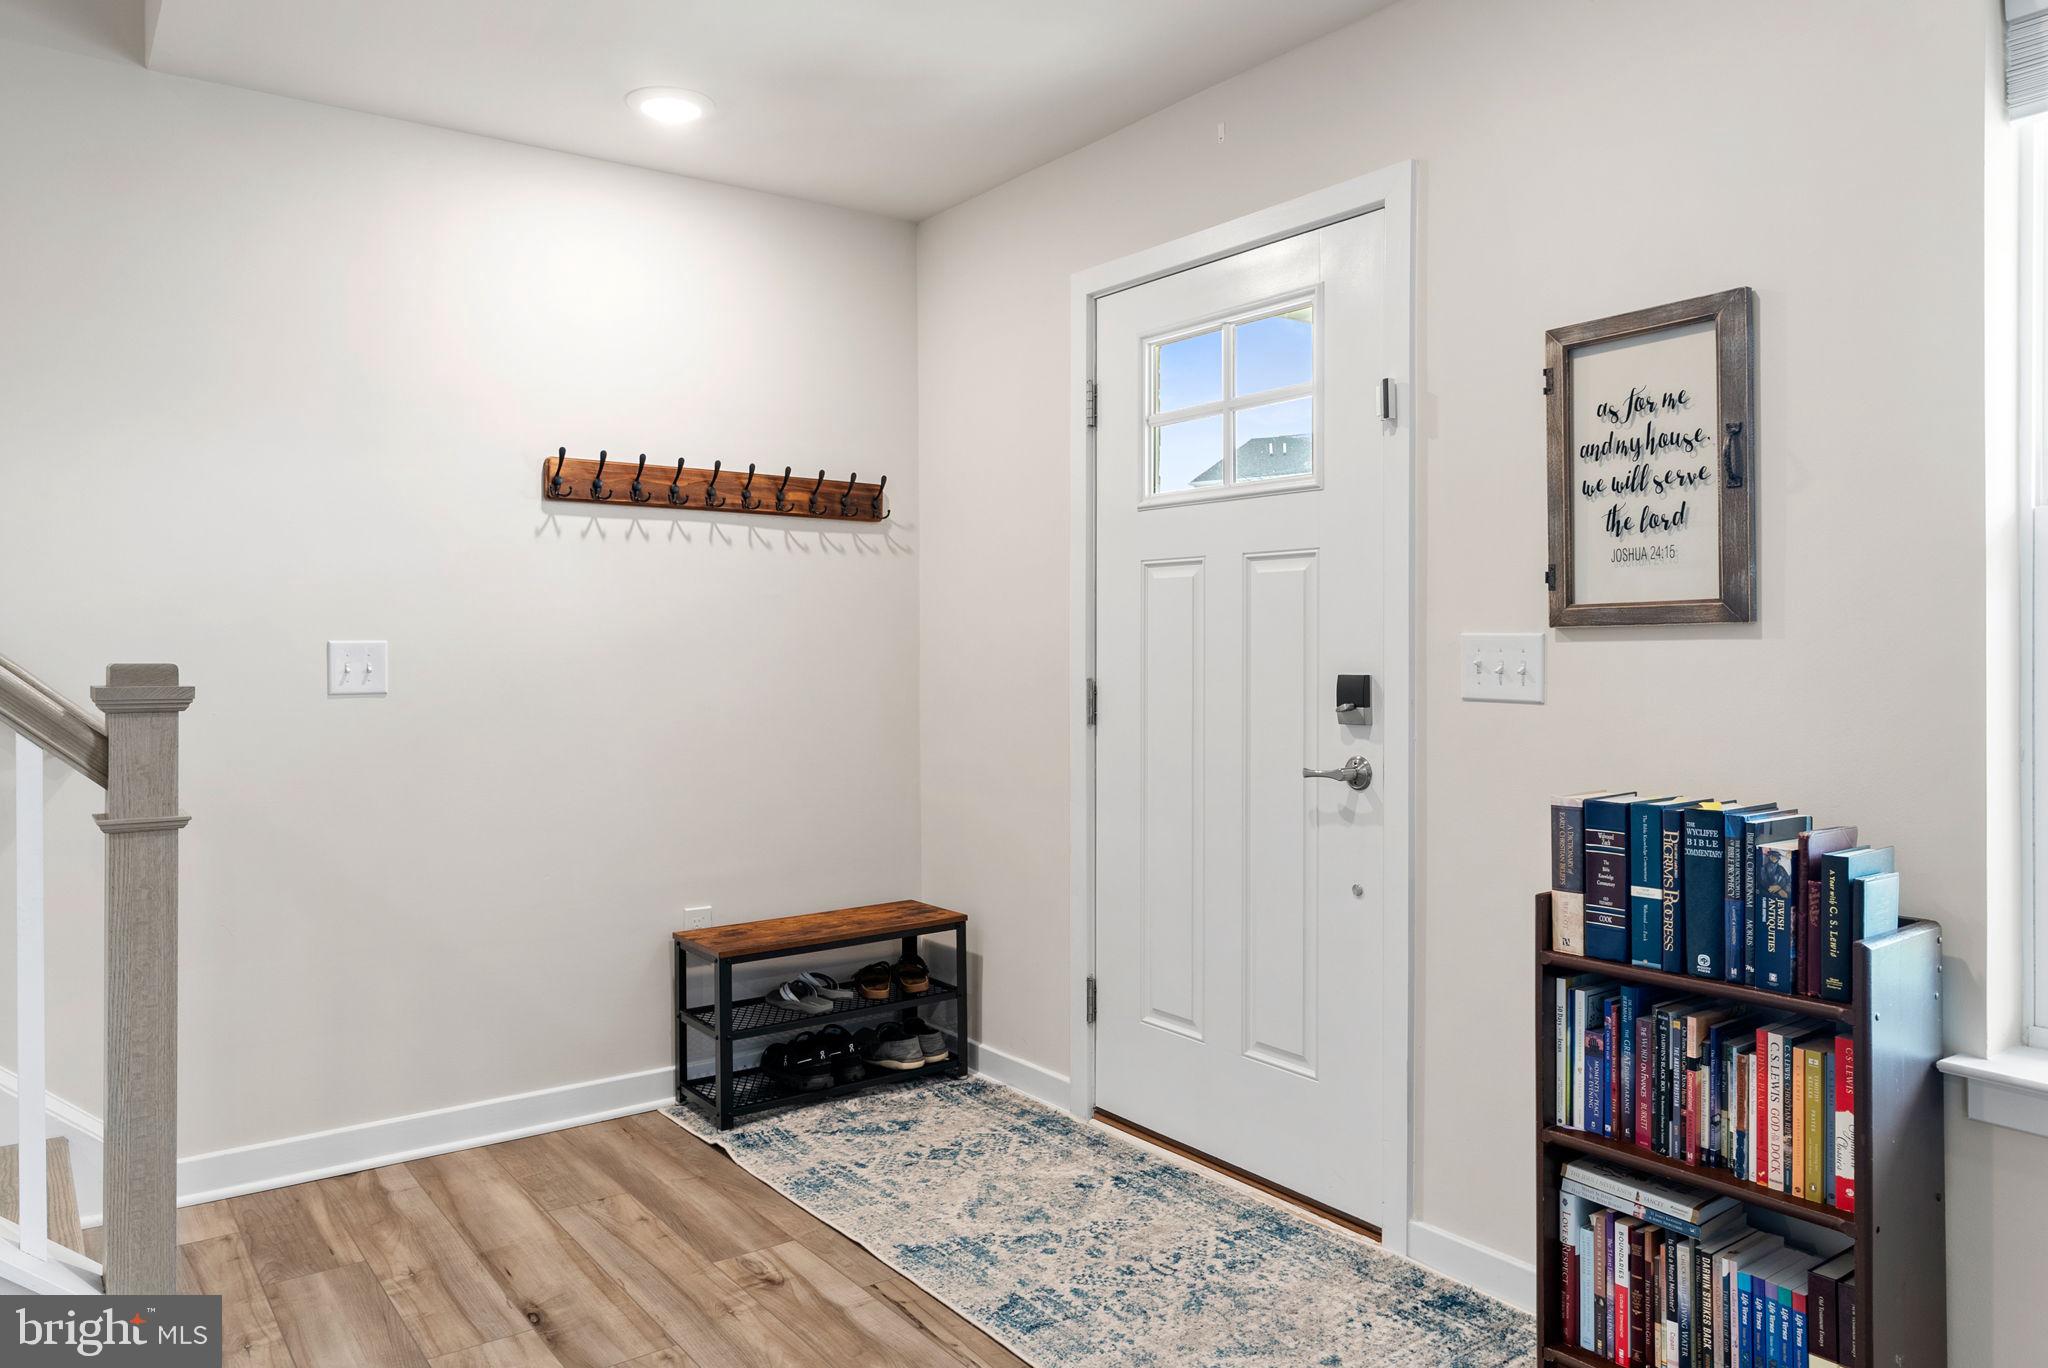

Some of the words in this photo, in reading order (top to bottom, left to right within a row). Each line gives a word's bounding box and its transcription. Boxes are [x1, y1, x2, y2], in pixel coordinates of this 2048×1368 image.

[1597, 403, 1619, 423] as
[1620, 385, 1656, 423] for
[1662, 389, 1690, 409] me
[1580, 431, 1614, 462] and
[1615, 437, 1641, 462] my
[1582, 478, 1607, 497] we
[1611, 463, 1650, 494] will
[1653, 465, 1712, 494] serve
[1602, 502, 1635, 537] the
[1611, 546, 1648, 563] JOSHUA
[1650, 544, 1676, 560] 24:15
[1686, 828, 1719, 838] WYCLIFFE
[1686, 838, 1719, 848] BIBLE
[1746, 832, 1755, 860] BIBLICAL
[1746, 861, 1755, 908] CREATIONISM
[1829, 891, 1837, 905] with
[1663, 889, 1680, 951] PROGRESS
[1767, 897, 1776, 953] ANTIQUITIES
[1776, 898, 1785, 931] JEWISH
[1829, 906, 1837, 917] C.
[1829, 920, 1837, 929] S.
[1746, 919, 1755, 946] MORRIS
[1829, 931, 1839, 958] Lewis
[1623, 1039, 1631, 1065] GREAT
[1770, 1042, 1780, 1053] C.
[1770, 1054, 1780, 1064] S.
[1770, 1065, 1780, 1104] LEWIS
[1845, 1064, 1854, 1095] LEWIS
[1640, 1102, 1648, 1130] BURKETT
[1770, 1107, 1780, 1132] GOD
[1770, 1142, 1780, 1175] DOCK
[1835, 1136, 1848, 1171] Classics
[1643, 1194, 1665, 1208] YANCEY
[1561, 1211, 1571, 1236] LOVE
[1561, 1243, 1571, 1286] RESPECT
[1702, 1257, 1711, 1289] DARWIN
[1702, 1291, 1711, 1326] STRIKES
[1741, 1293, 1749, 1306] Life
[1755, 1297, 1763, 1311] Life
[1767, 1301, 1776, 1314] Life
[1780, 1307, 1789, 1320] Life
[1794, 1313, 1803, 1327] Life
[1702, 1326, 1711, 1350] BACK
